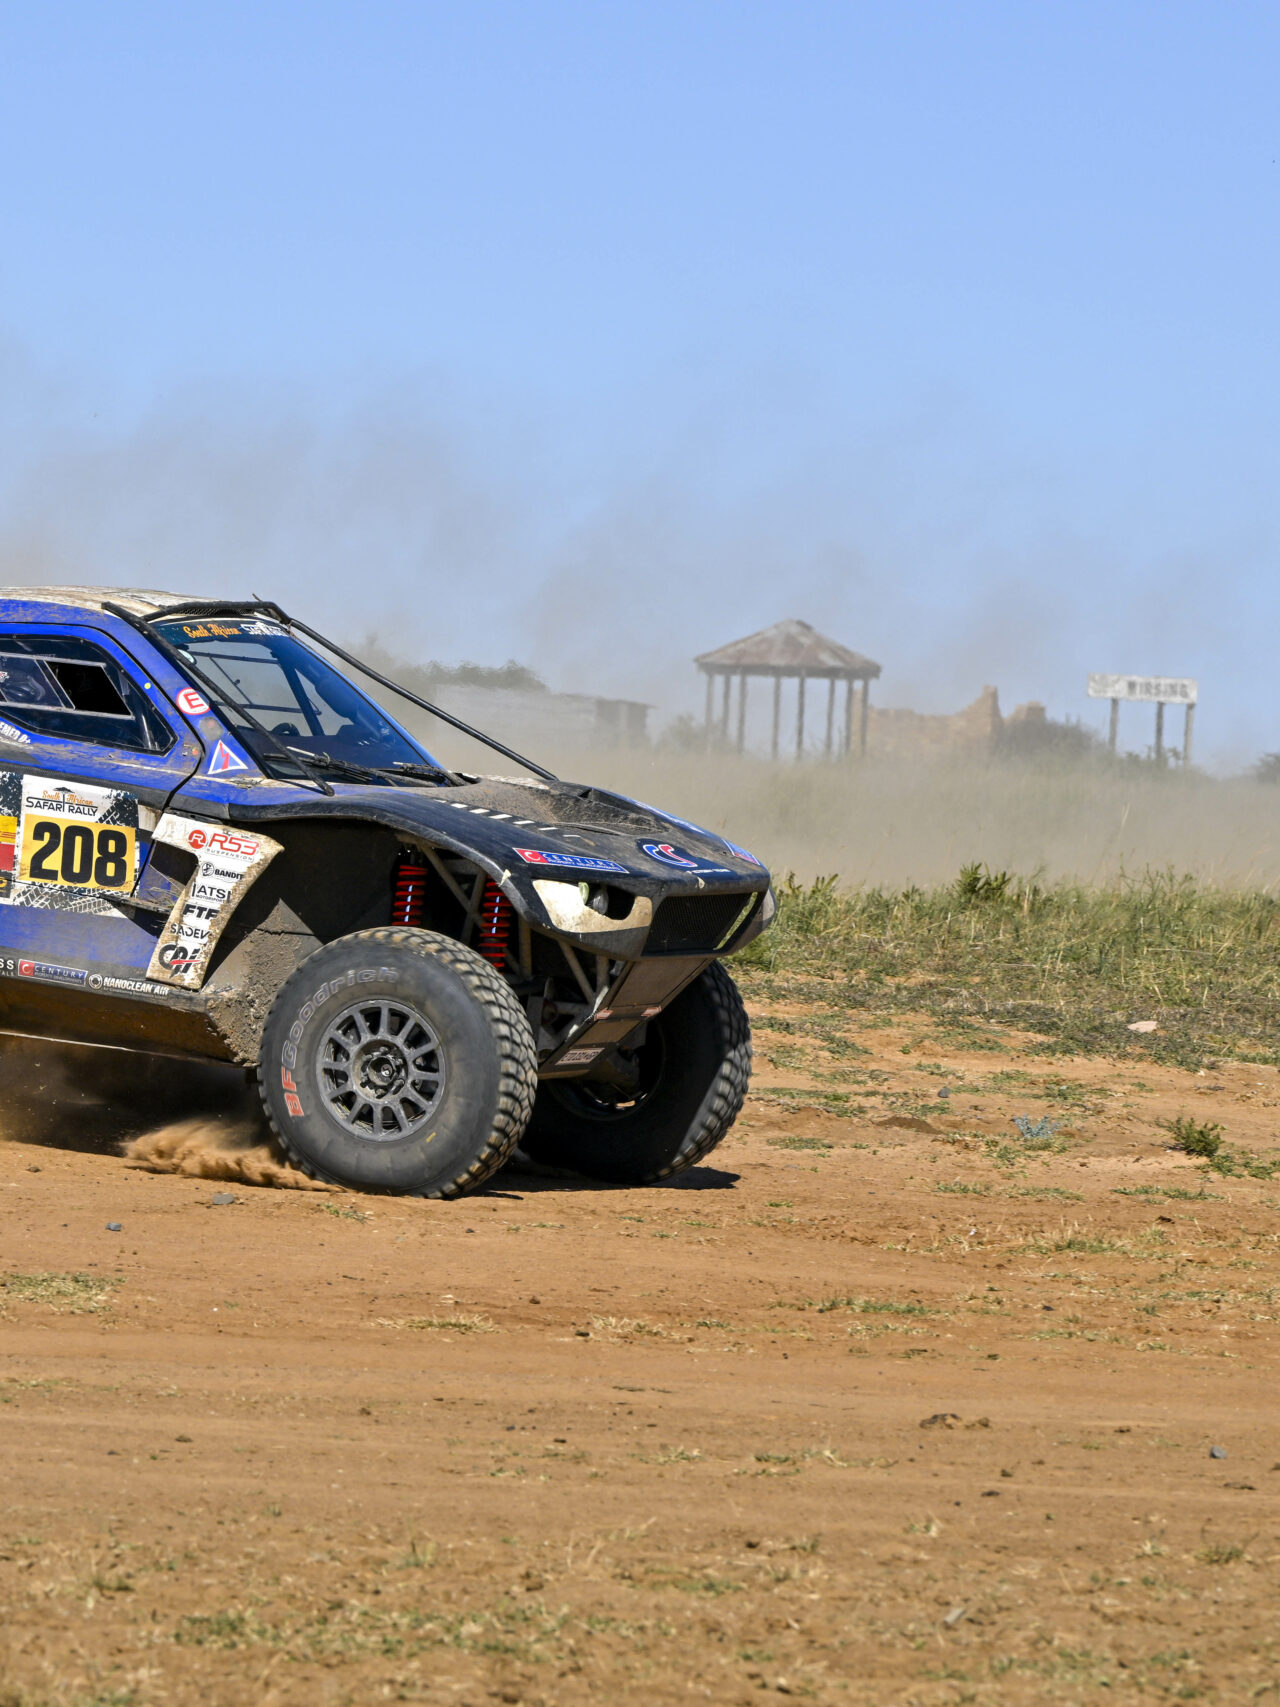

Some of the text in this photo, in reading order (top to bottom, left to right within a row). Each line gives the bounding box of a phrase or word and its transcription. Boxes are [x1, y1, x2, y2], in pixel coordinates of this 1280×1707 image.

[183, 692, 204, 709] E
[25, 796, 98, 816] SAFARI RALLY
[42, 790, 94, 806] South African
[29, 821, 128, 888] 208
[543, 853, 616, 867] CENTURY
[214, 868, 244, 881] BANDIT
[197, 885, 226, 899] ATS
[182, 904, 220, 920] FTF
[170, 923, 211, 939] SADEV
[34, 965, 84, 978] CENTURY
[103, 977, 152, 992] NANOCLEAN
[153, 985, 170, 995] AIR
